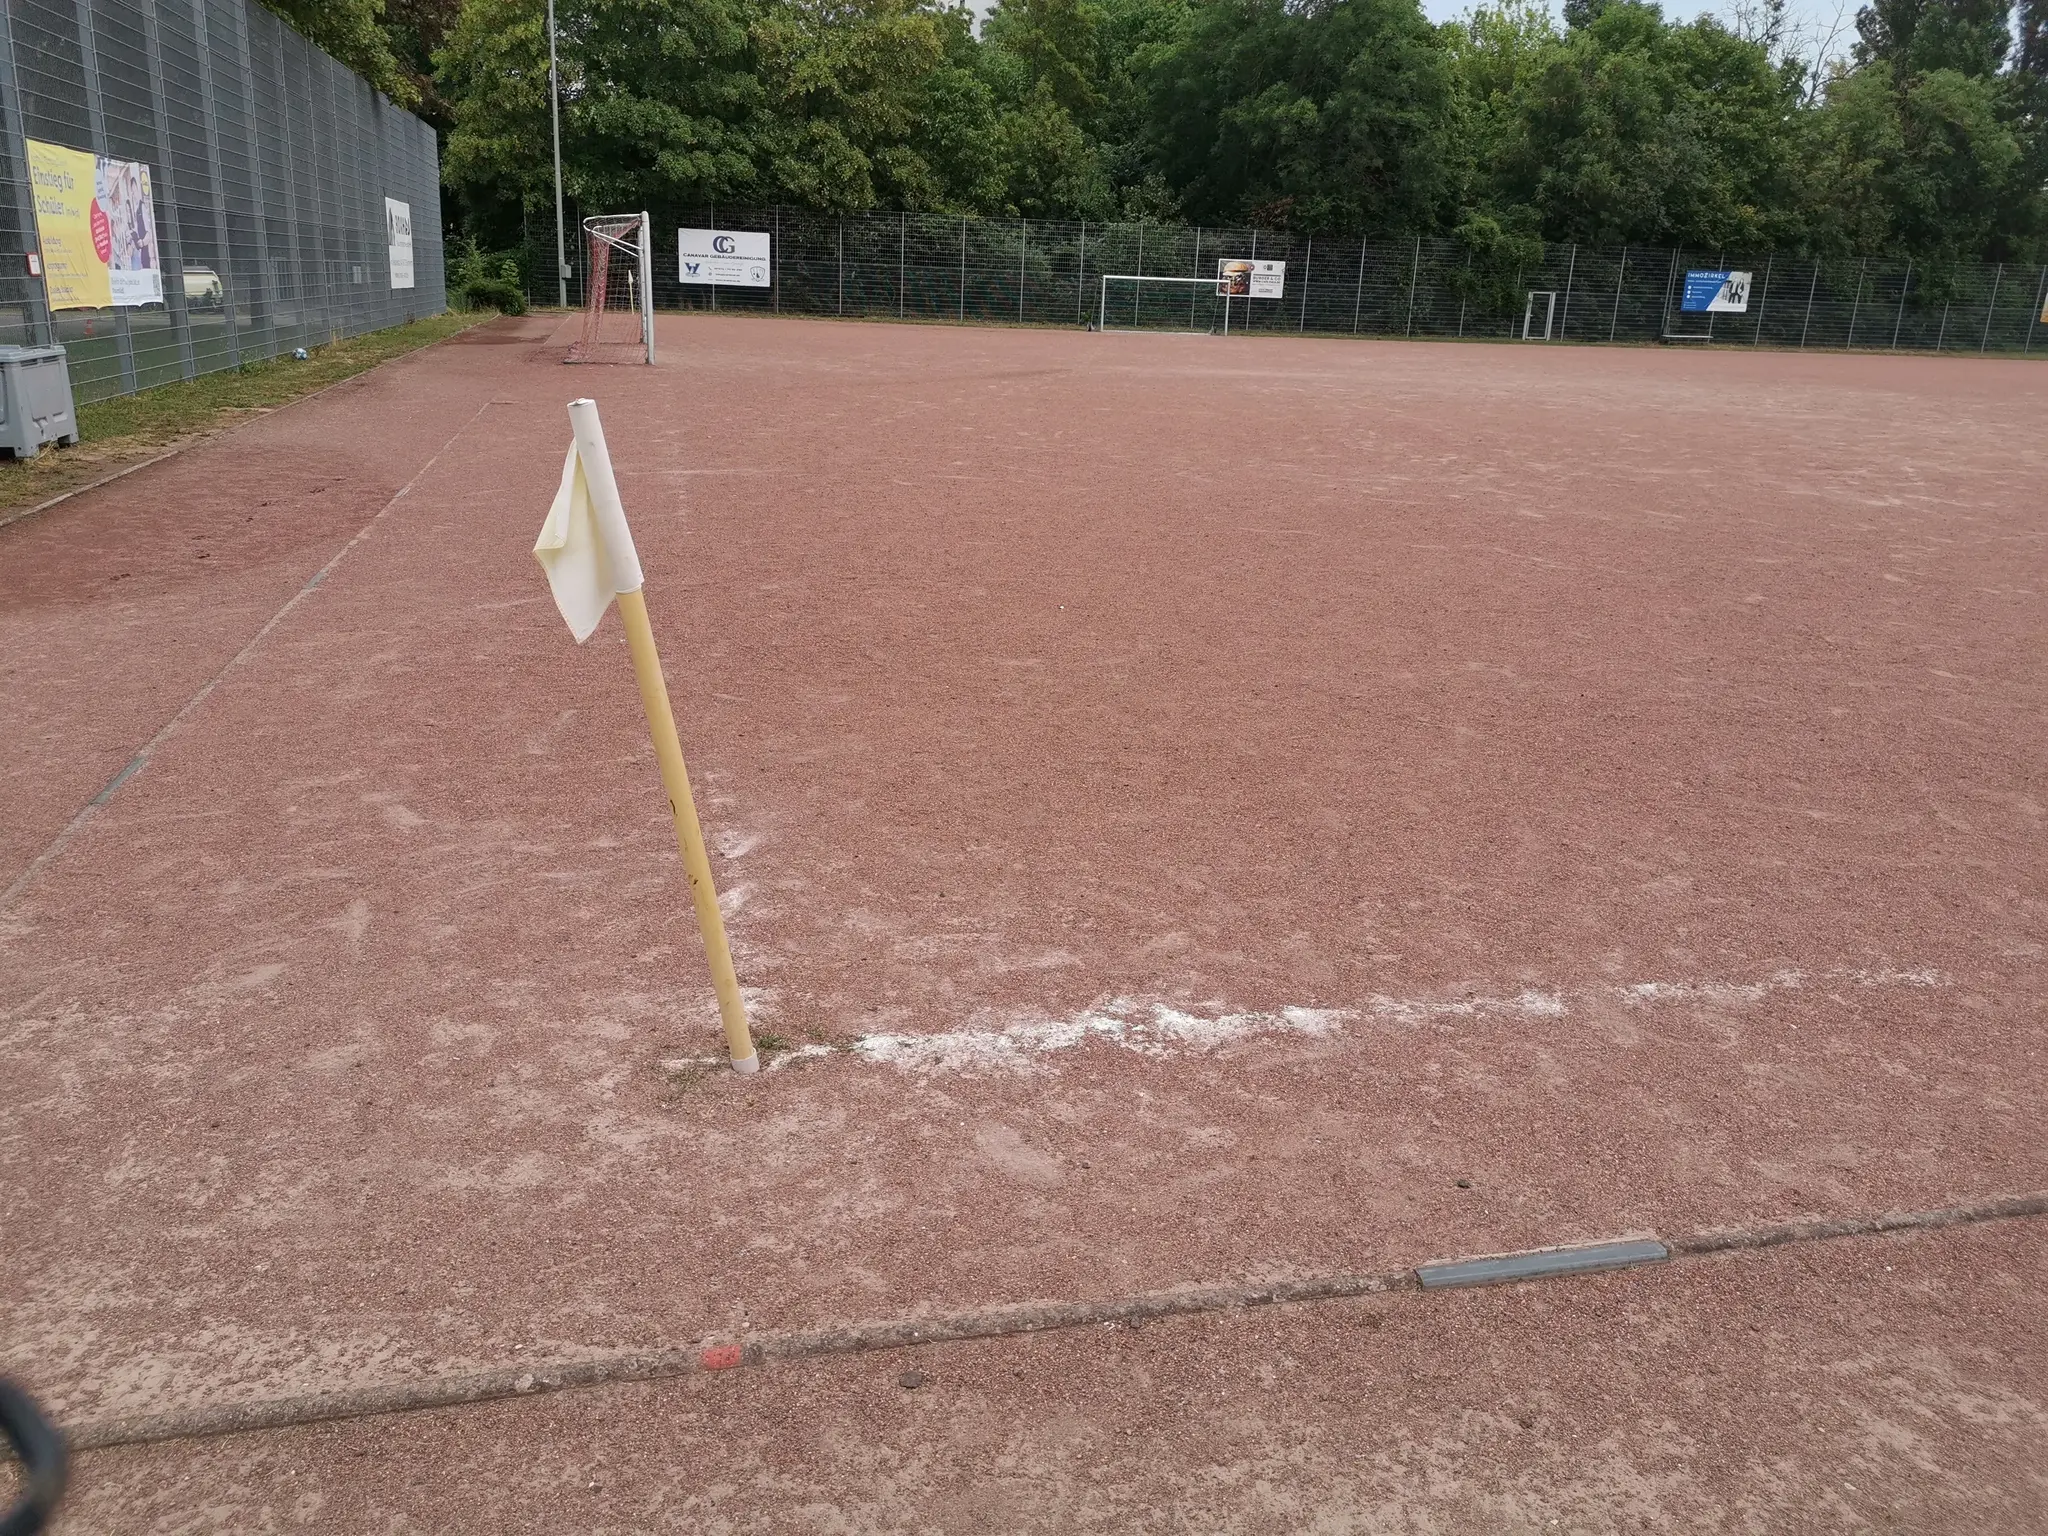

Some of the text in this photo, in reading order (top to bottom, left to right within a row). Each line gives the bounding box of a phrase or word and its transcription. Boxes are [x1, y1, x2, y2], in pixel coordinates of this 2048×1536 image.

[32, 165, 63, 193] Einstieg
[63, 171, 74, 190] für
[36, 195, 64, 216] Schüler
